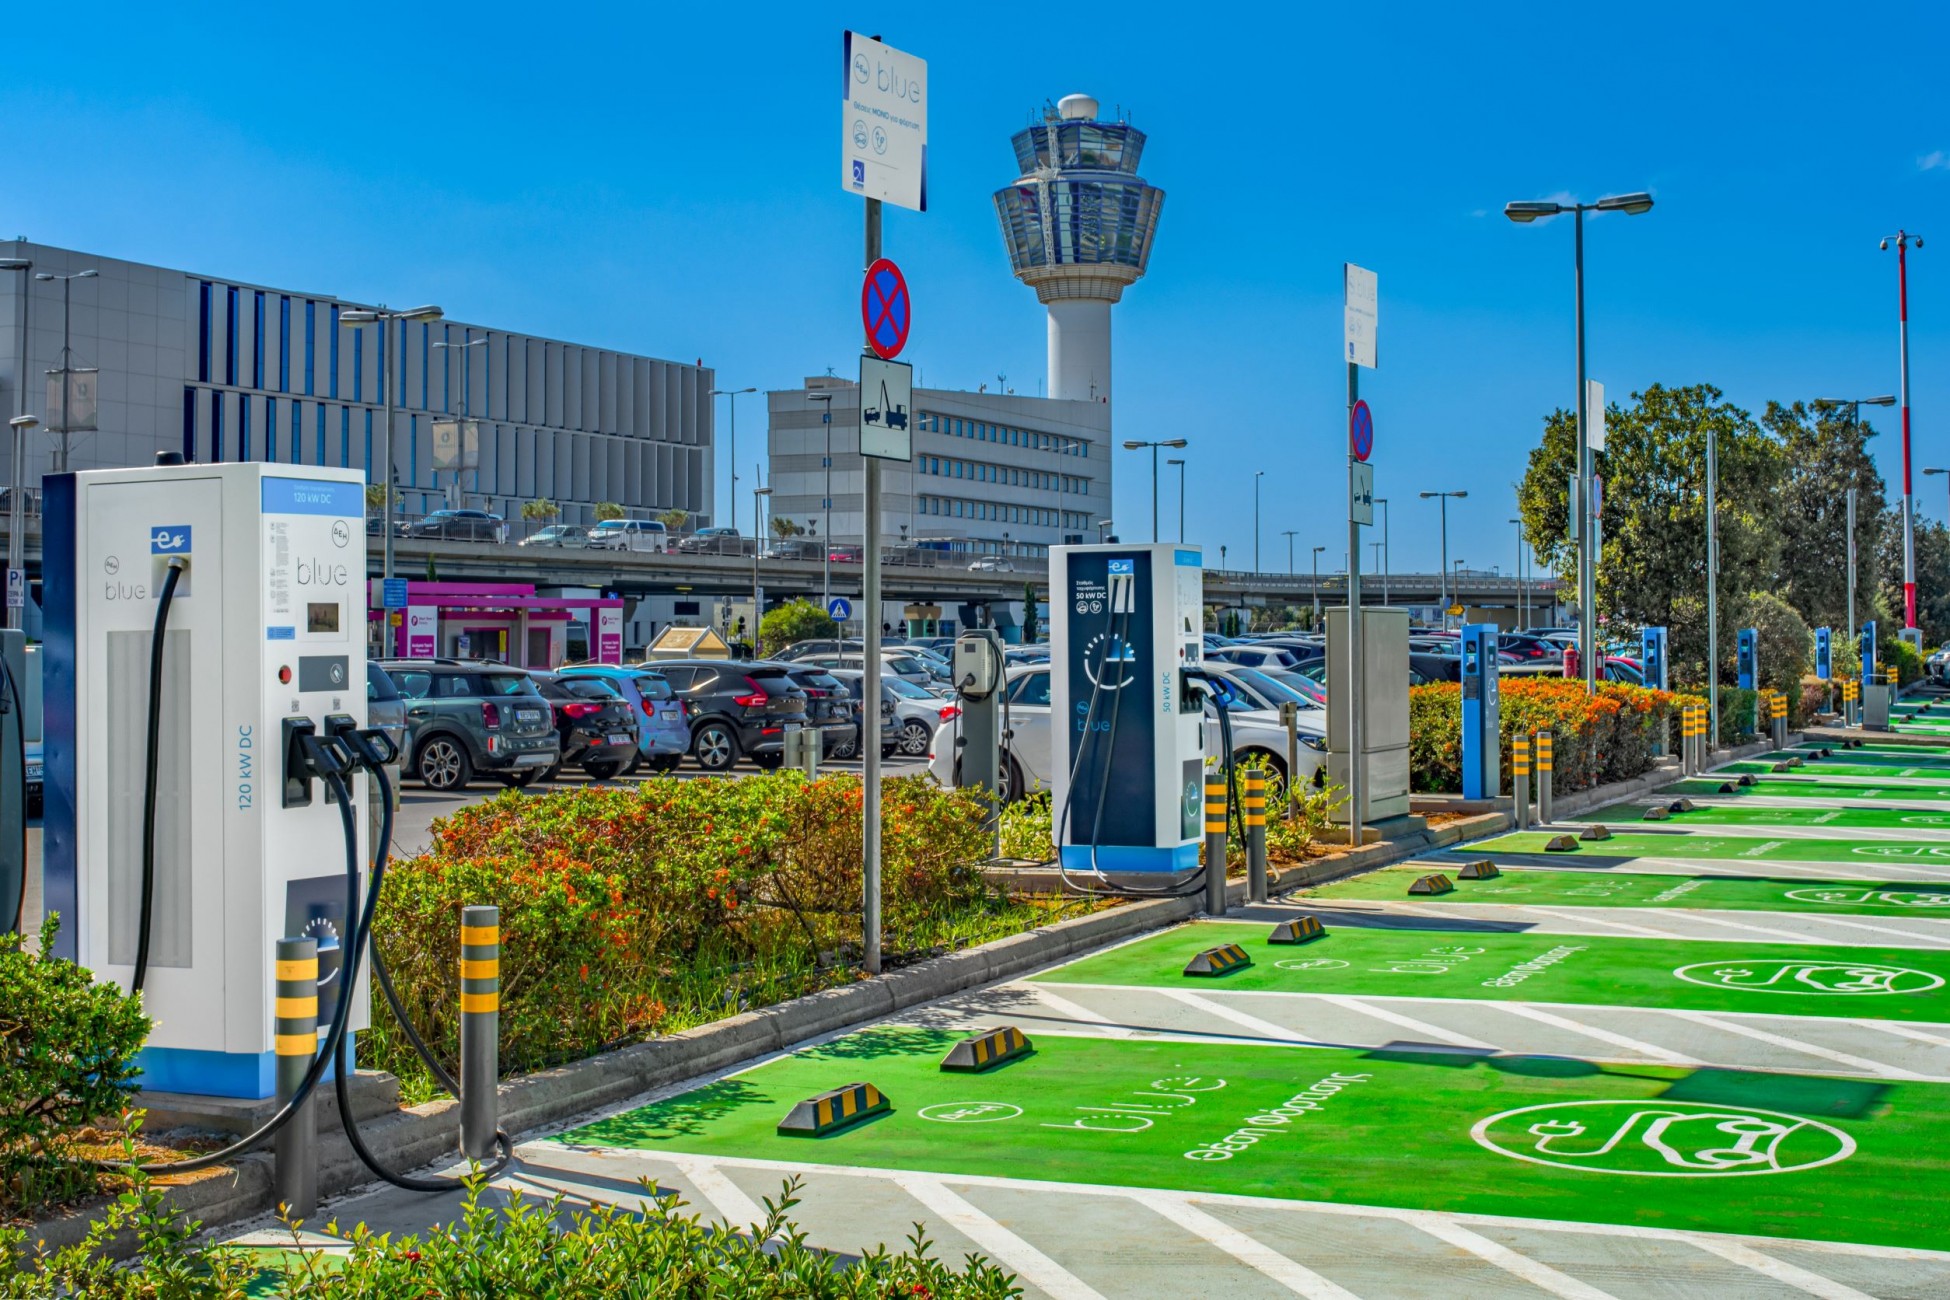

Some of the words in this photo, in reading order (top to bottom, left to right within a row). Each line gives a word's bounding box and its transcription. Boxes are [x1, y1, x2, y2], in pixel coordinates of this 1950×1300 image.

[877, 60, 920, 104] blue
[293, 492, 307, 503] 120
[307, 492, 320, 504] kW
[320, 493, 332, 505] DC
[333, 527, 348, 540] ΔΕΗ
[297, 556, 348, 586] blue
[105, 581, 145, 601] blue
[1075, 592, 1085, 600] 50
[1096, 591, 1107, 599] DC
[1163, 671, 1171, 683] DC
[1163, 684, 1171, 700] kW
[1163, 701, 1171, 713] 50
[1077, 718, 1111, 732] bue
[238, 725, 252, 748] DC
[238, 753, 252, 779] kW
[238, 784, 252, 811] 120
[937, 1104, 1005, 1121] ΔΕΗ
[1039, 1076, 1228, 1133] blue
[1184, 1127, 1289, 1161] Θέση
[1243, 1072, 1374, 1126] φόρτισης
